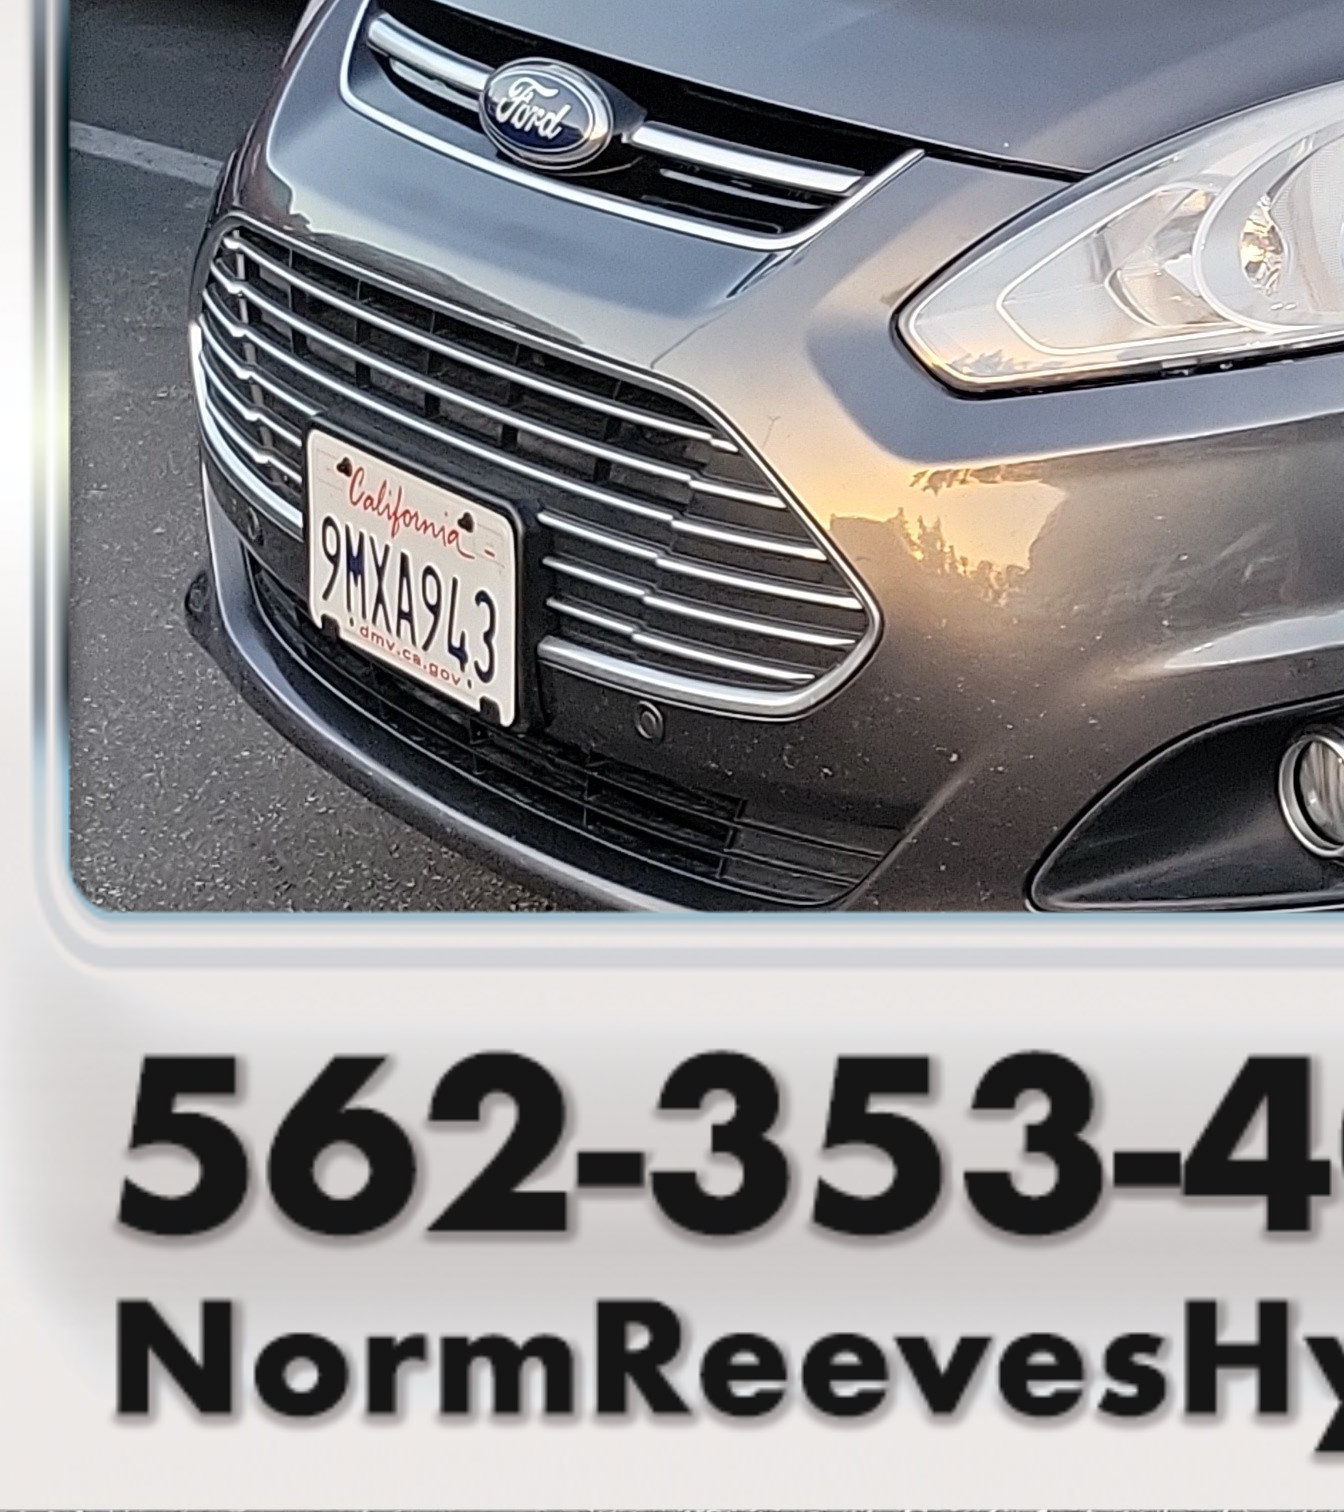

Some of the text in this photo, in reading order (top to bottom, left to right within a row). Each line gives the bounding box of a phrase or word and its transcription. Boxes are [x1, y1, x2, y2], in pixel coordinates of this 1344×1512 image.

[496, 77, 571, 139] Ford
[349, 467, 475, 560] California
[321, 515, 496, 684] 9MXA943
[359, 625, 462, 686] dmv.ca.gov
